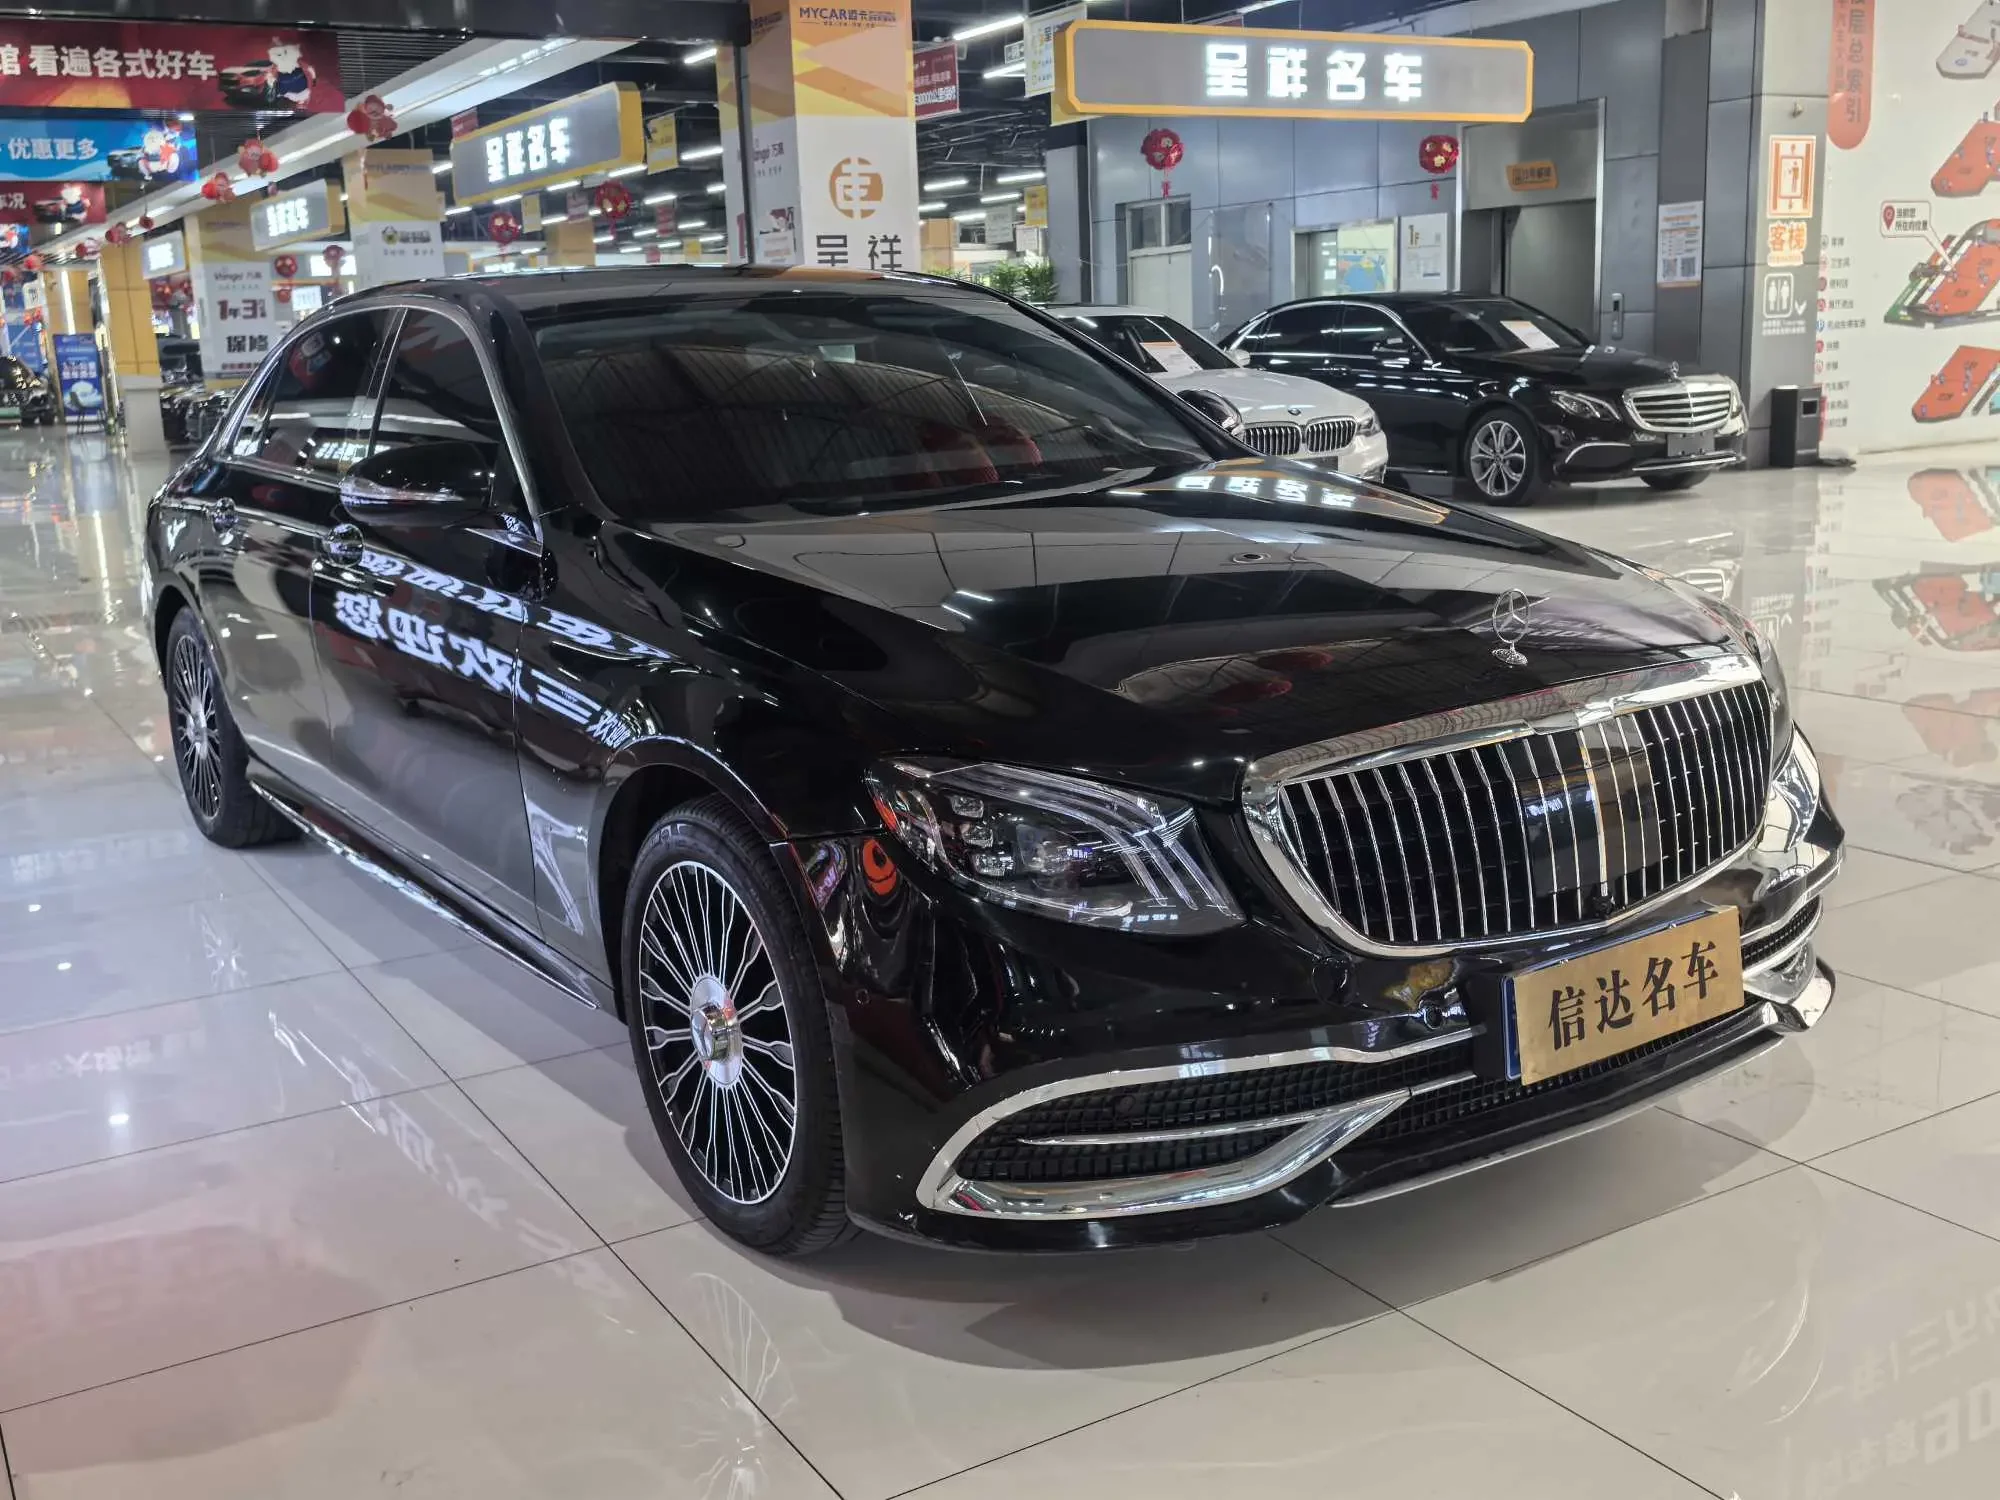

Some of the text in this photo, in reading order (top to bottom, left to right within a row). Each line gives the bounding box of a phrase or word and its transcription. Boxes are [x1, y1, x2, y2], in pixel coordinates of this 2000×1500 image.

[30, 45, 217, 80] 看遍各式好车
[1206, 43, 1423, 101] 呈祥名车
[8, 138, 99, 161] 优惠更多
[816, 234, 902, 270] 呈祥
[1548, 941, 1718, 1051] 信达名车
